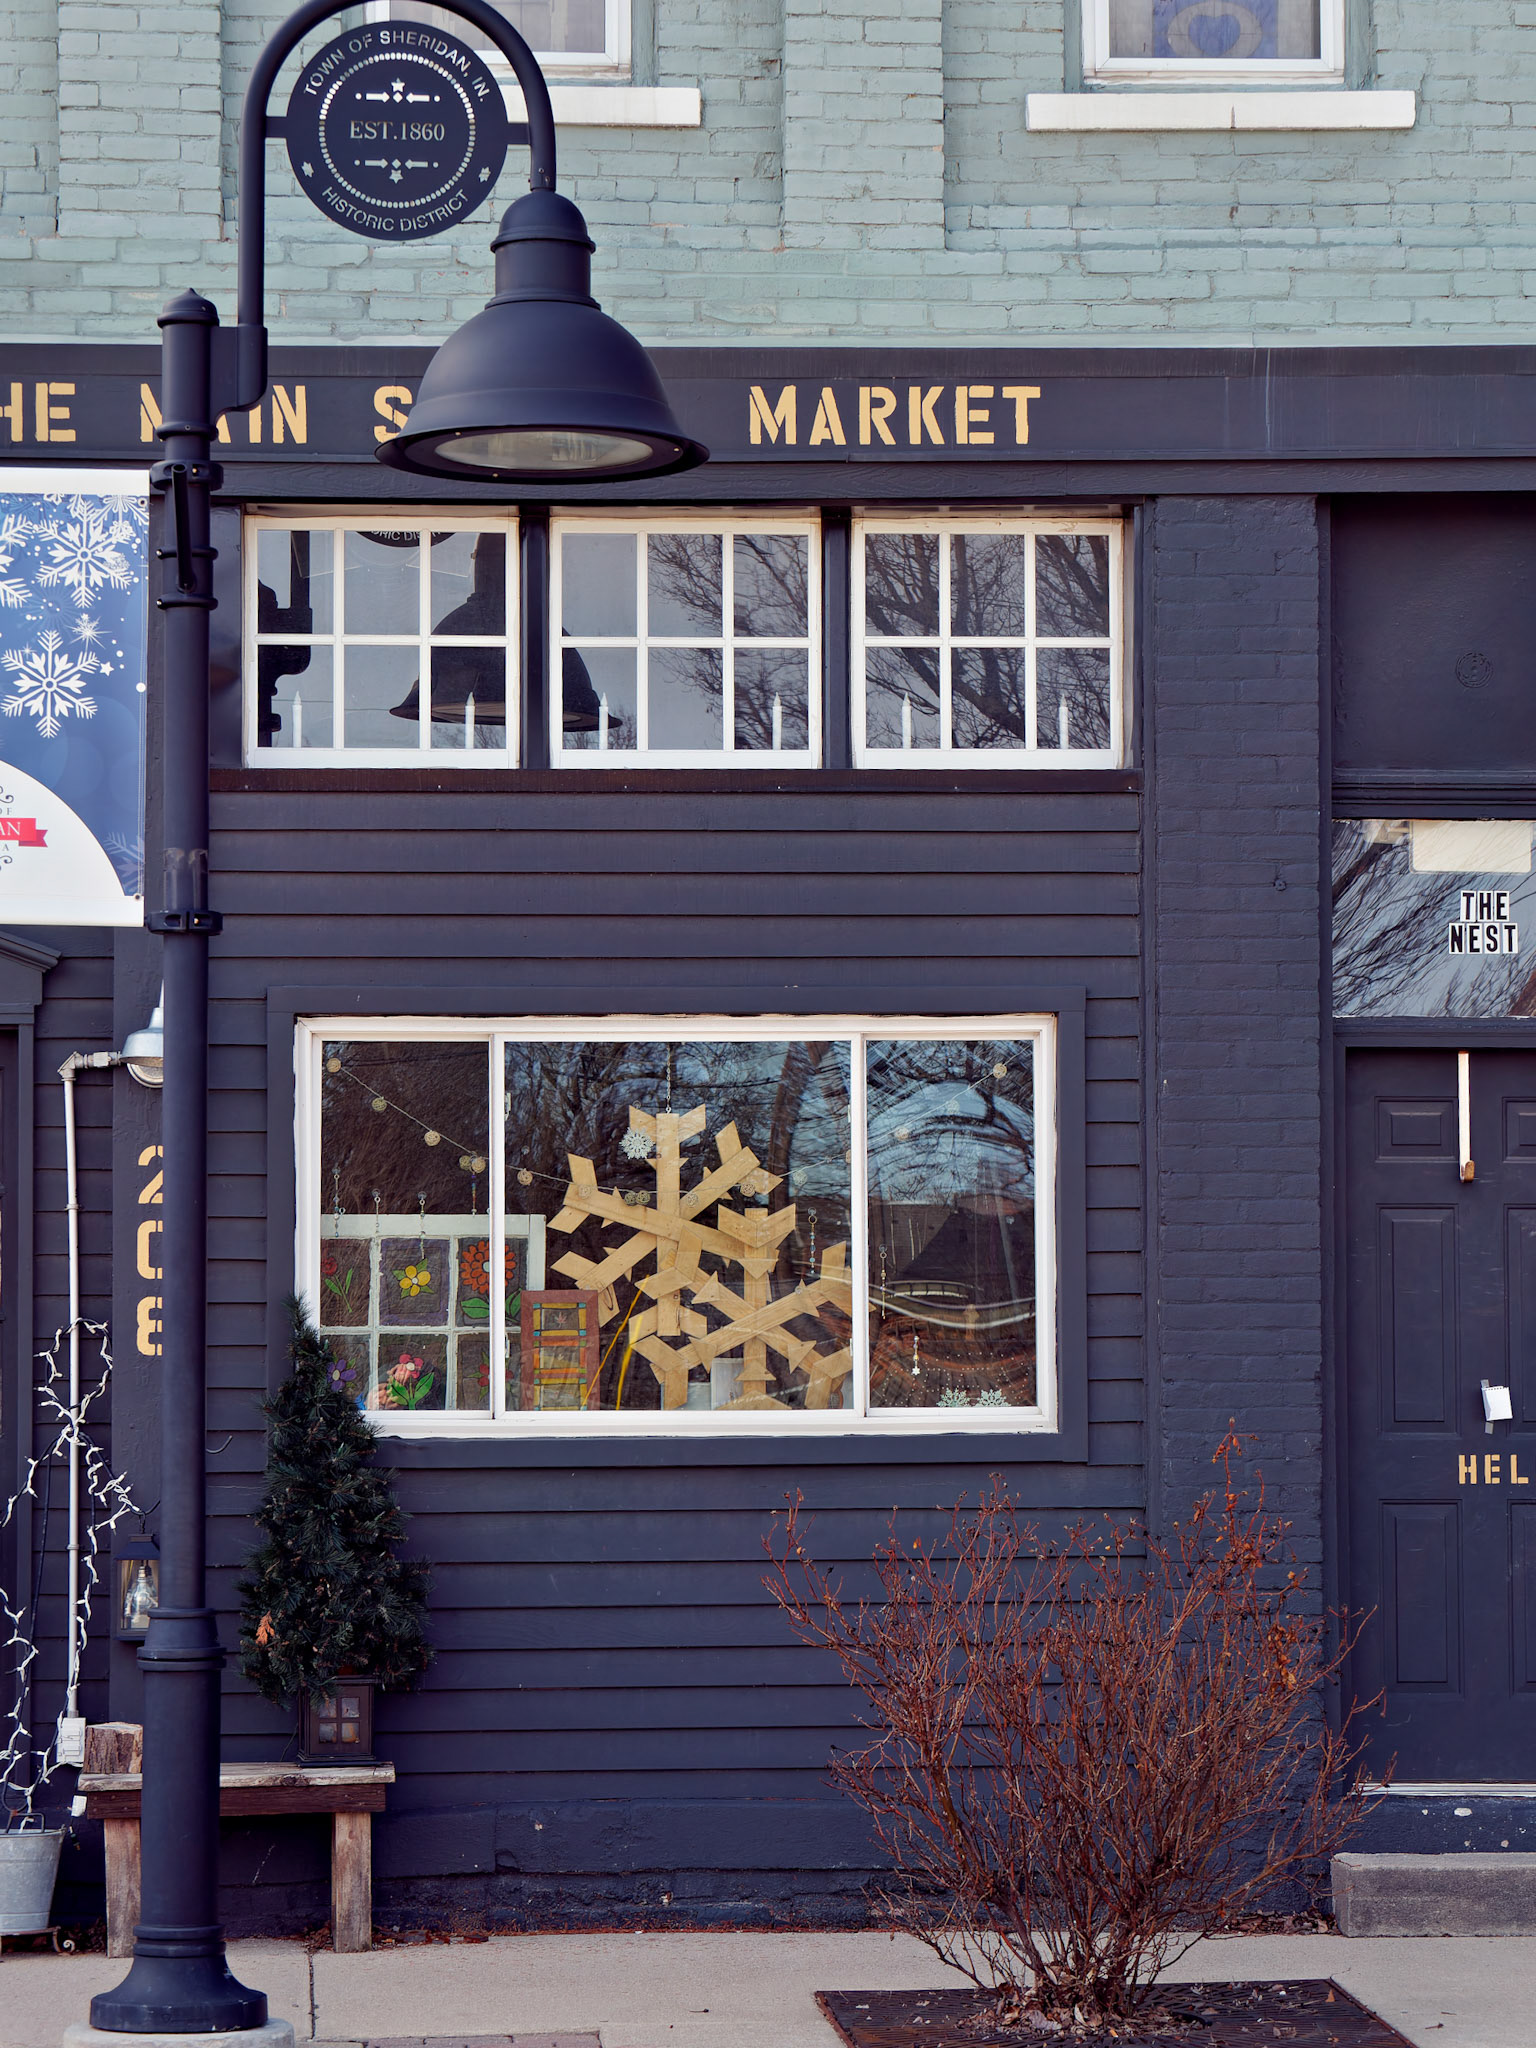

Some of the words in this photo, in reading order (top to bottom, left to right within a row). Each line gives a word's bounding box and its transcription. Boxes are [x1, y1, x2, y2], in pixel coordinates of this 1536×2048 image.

[304, 48, 346, 97] TOWN
[348, 33, 373, 54] OF
[380, 30, 471, 78] SHERIDAN,
[321, 186, 395, 232] HISTORIC
[400, 189, 470, 232] DISTRICT
[749, 385, 1041, 445] MARKET
[1462, 892, 1508, 920] THE
[1450, 925, 1516, 953] NEST
[1459, 1454, 1529, 1485] HEL
